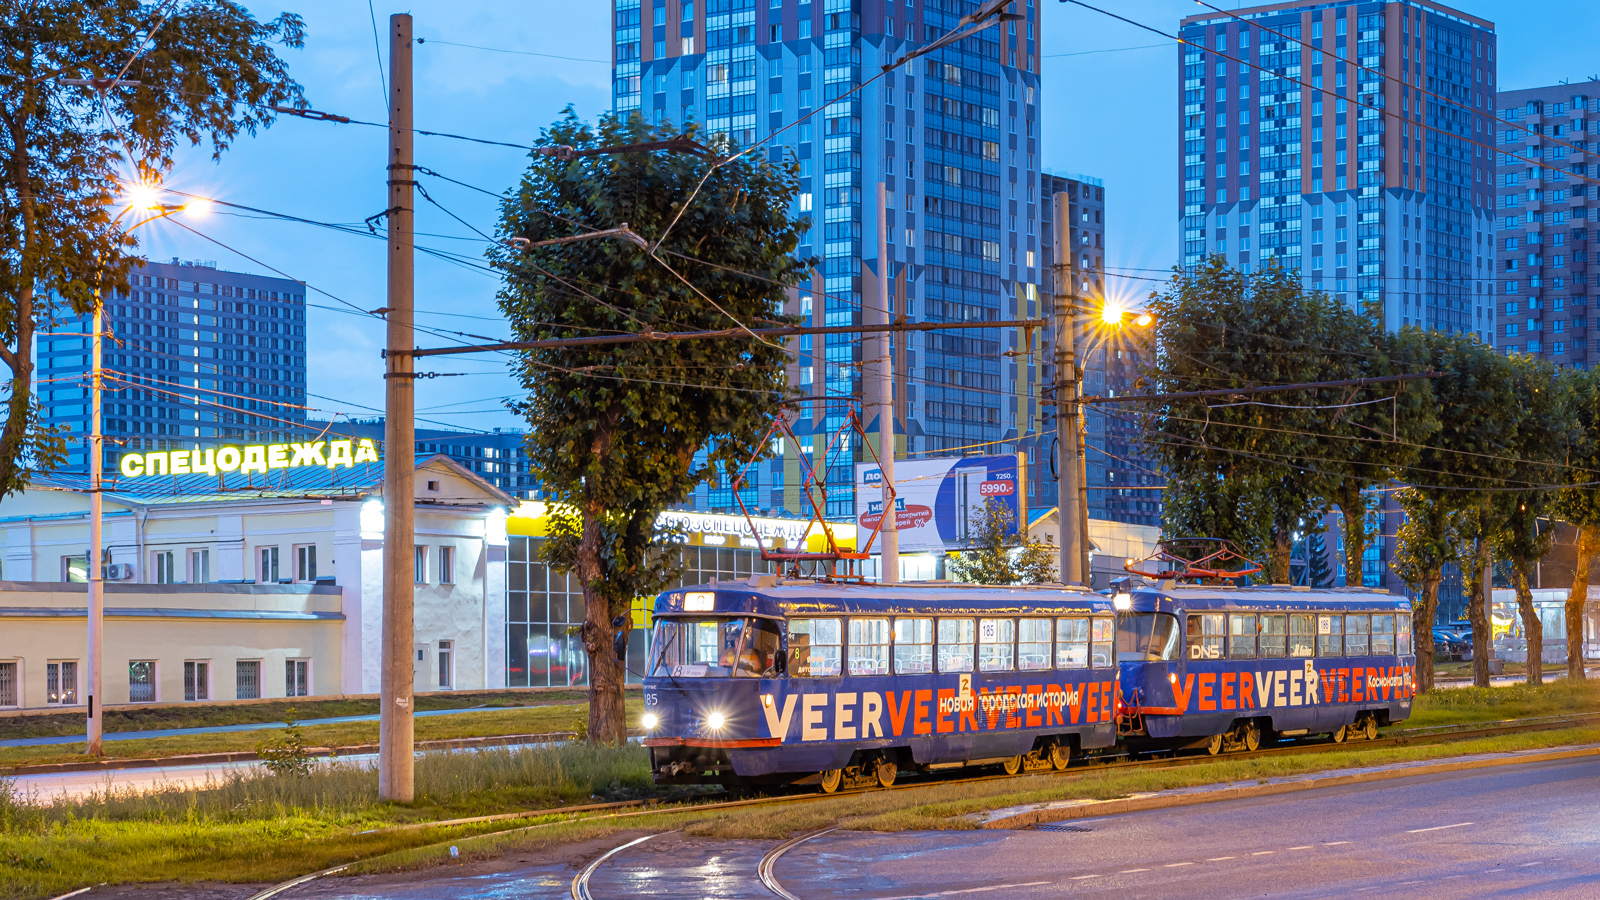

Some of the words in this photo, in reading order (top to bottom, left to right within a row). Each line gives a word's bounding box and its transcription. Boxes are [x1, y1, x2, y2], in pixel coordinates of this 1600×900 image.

[120, 438, 379, 478] СПЕЦОДЕЖДА
[980, 483, 1013, 494] 5990.-
[871, 500, 903, 512] МЕЦ
[983, 624, 994, 637] 185
[794, 647, 800, 659] 8
[1191, 644, 1220, 659] DNS
[673, 665, 683, 677] 8
[1306, 663, 1312, 673] 2
[961, 678, 969, 691] 2
[939, 696, 974, 712] новая
[978, 692, 1034, 716] городская
[1036, 690, 1079, 712] история
